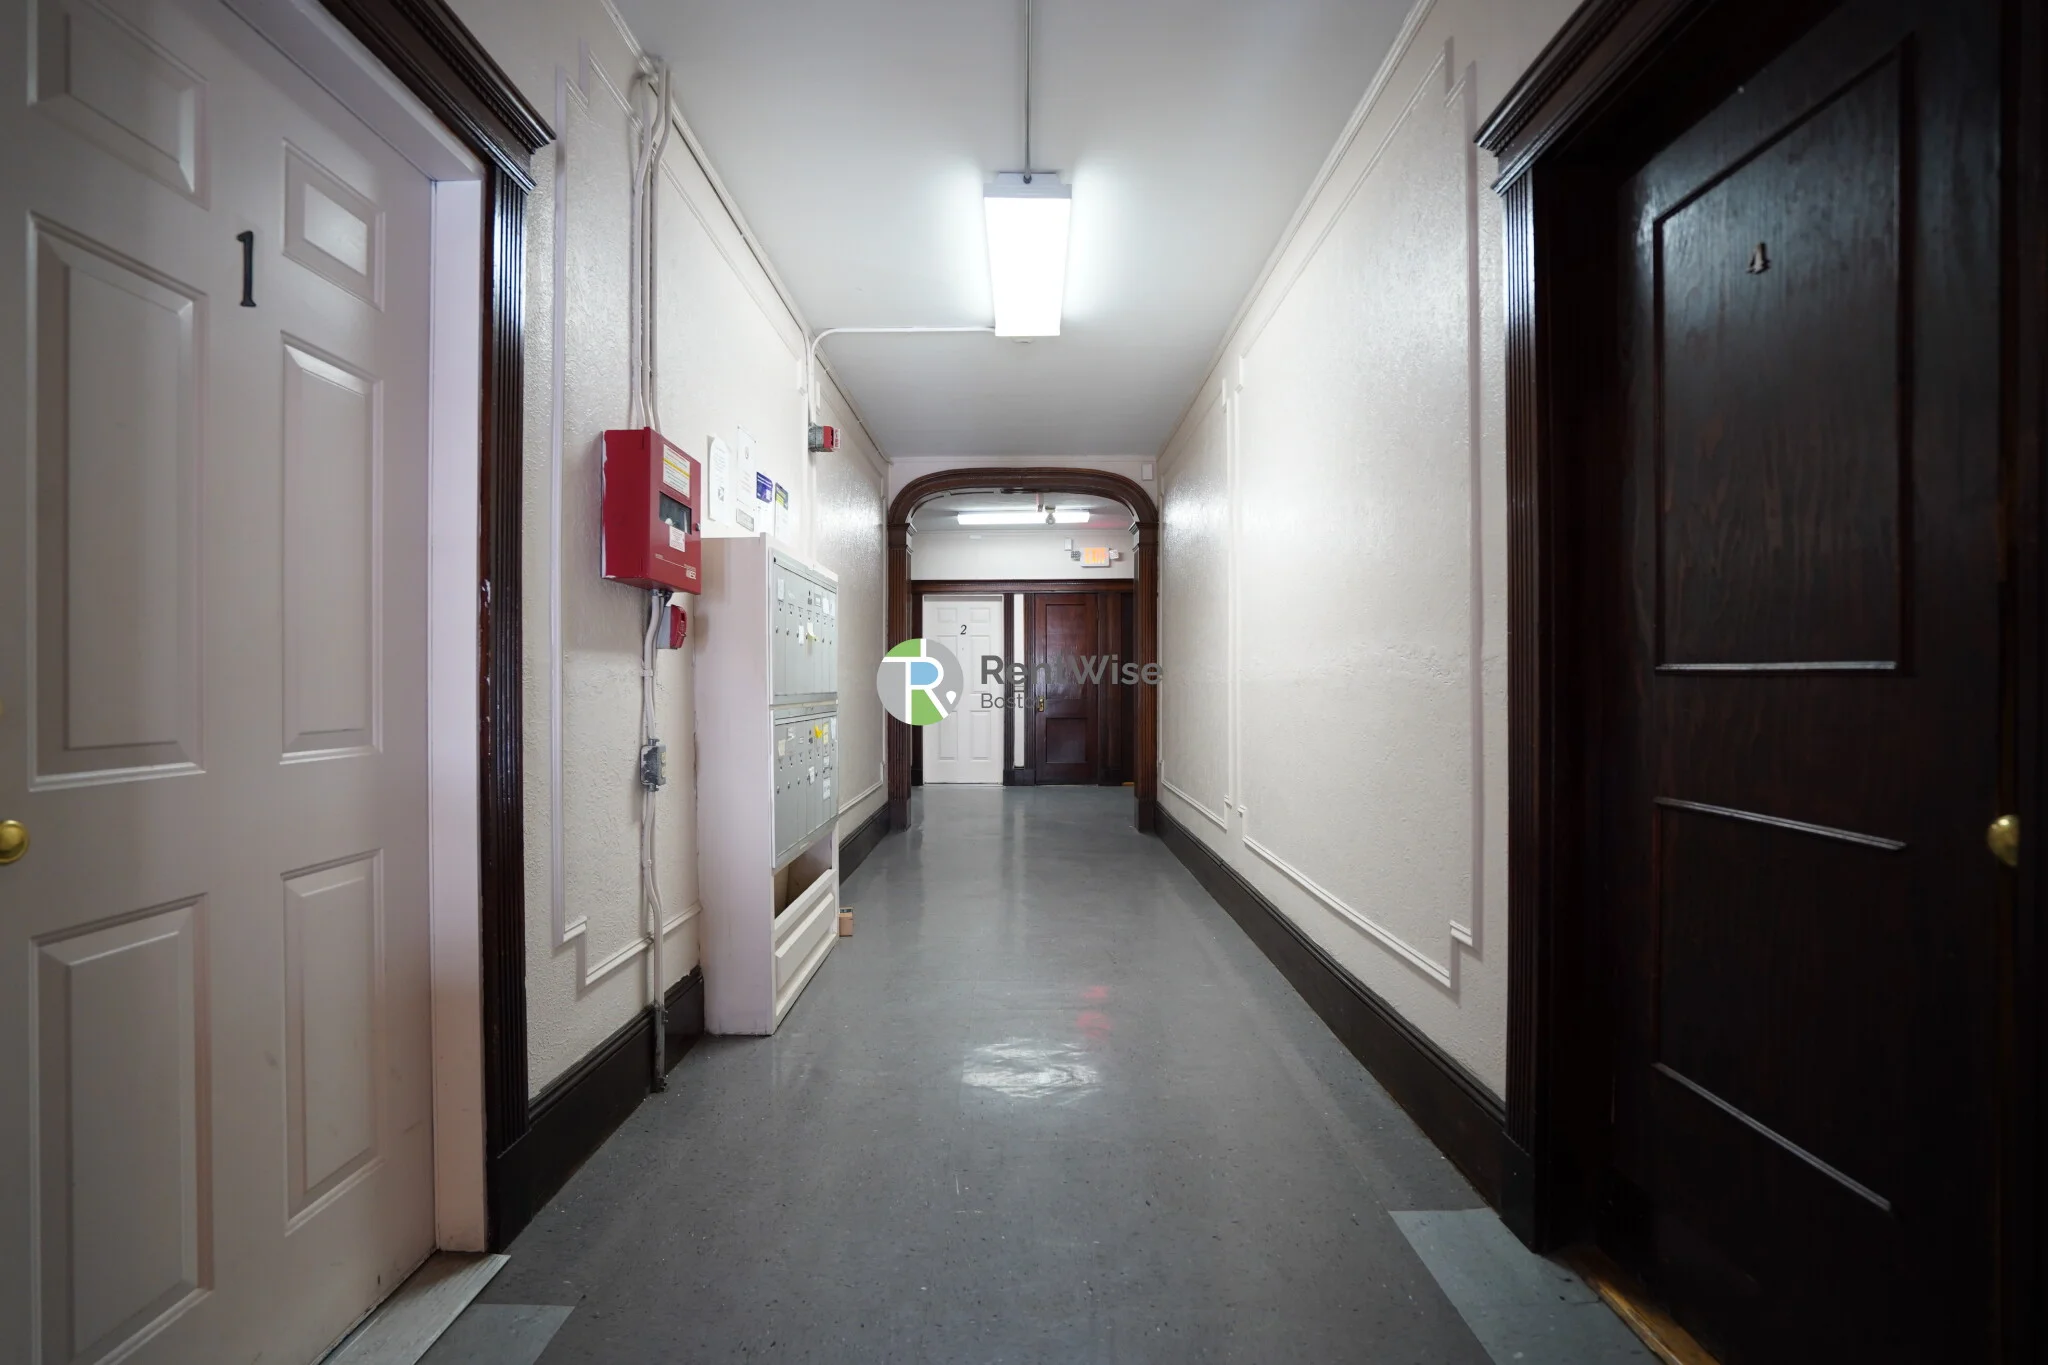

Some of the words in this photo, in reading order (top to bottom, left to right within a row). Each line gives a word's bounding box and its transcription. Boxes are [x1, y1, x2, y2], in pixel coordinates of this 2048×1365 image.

[236, 230, 256, 307] 1
[1746, 241, 1771, 275] 4
[960, 624, 967, 635] 2
